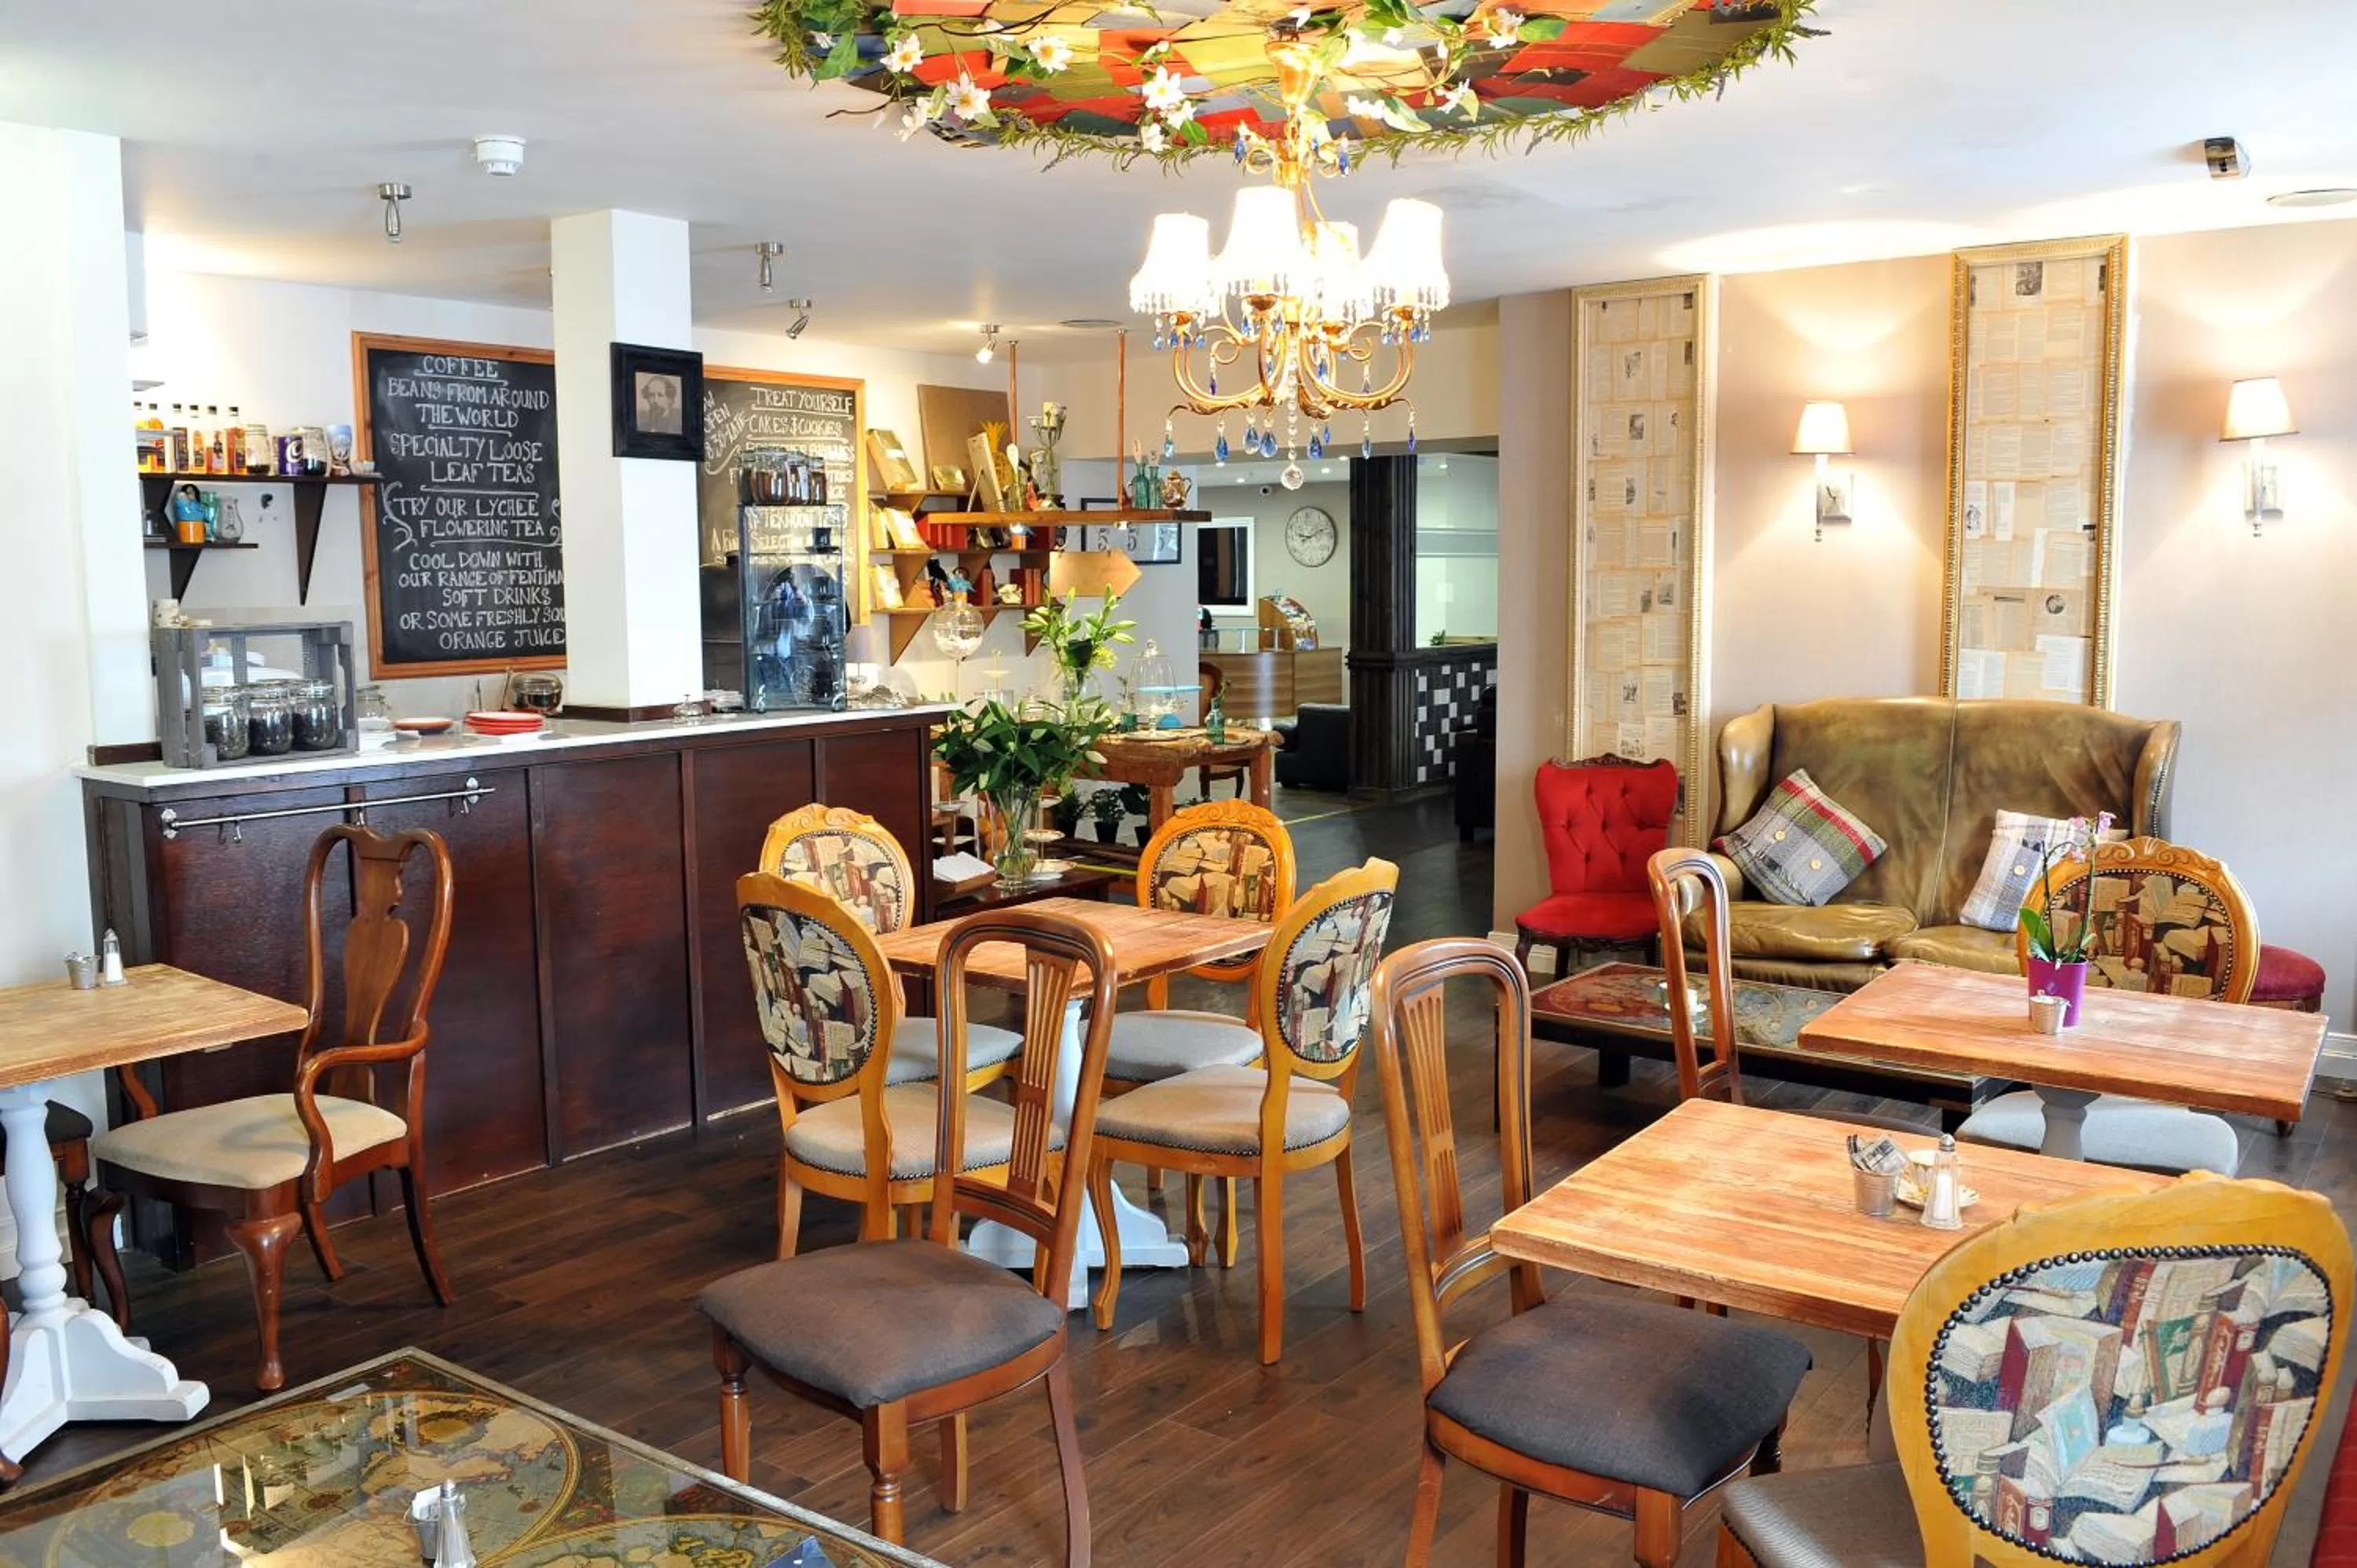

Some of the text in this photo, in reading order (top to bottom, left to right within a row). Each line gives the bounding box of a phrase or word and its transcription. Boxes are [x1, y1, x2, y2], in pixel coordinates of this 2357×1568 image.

[423, 355, 498, 377] COFFEE
[387, 377, 550, 410] BEANS FROM AROUND
[749, 386, 854, 414] TREAT YOURSELF
[414, 403, 519, 428] THE WORLD
[749, 414, 789, 434] CAKES
[799, 419, 843, 438] COOKIES
[390, 432, 543, 462] SPECIALTY LOOSE
[431, 460, 536, 484] LEAF TEAS
[393, 496, 541, 518] TRY OUR LYCHEE
[420, 519, 545, 538] FLOWERING TEA
[409, 551, 543, 570] COOL DOWN WITH
[398, 571, 432, 588] OUR
[438, 570, 488, 588] RANGE
[488, 571, 508, 586] OF
[442, 586, 552, 607] SOFT DRINKS
[400, 612, 423, 630] OR
[426, 610, 473, 628] SOME
[475, 607, 541, 628] FRESHLY
[439, 628, 565, 650] ORANGE JUICE
